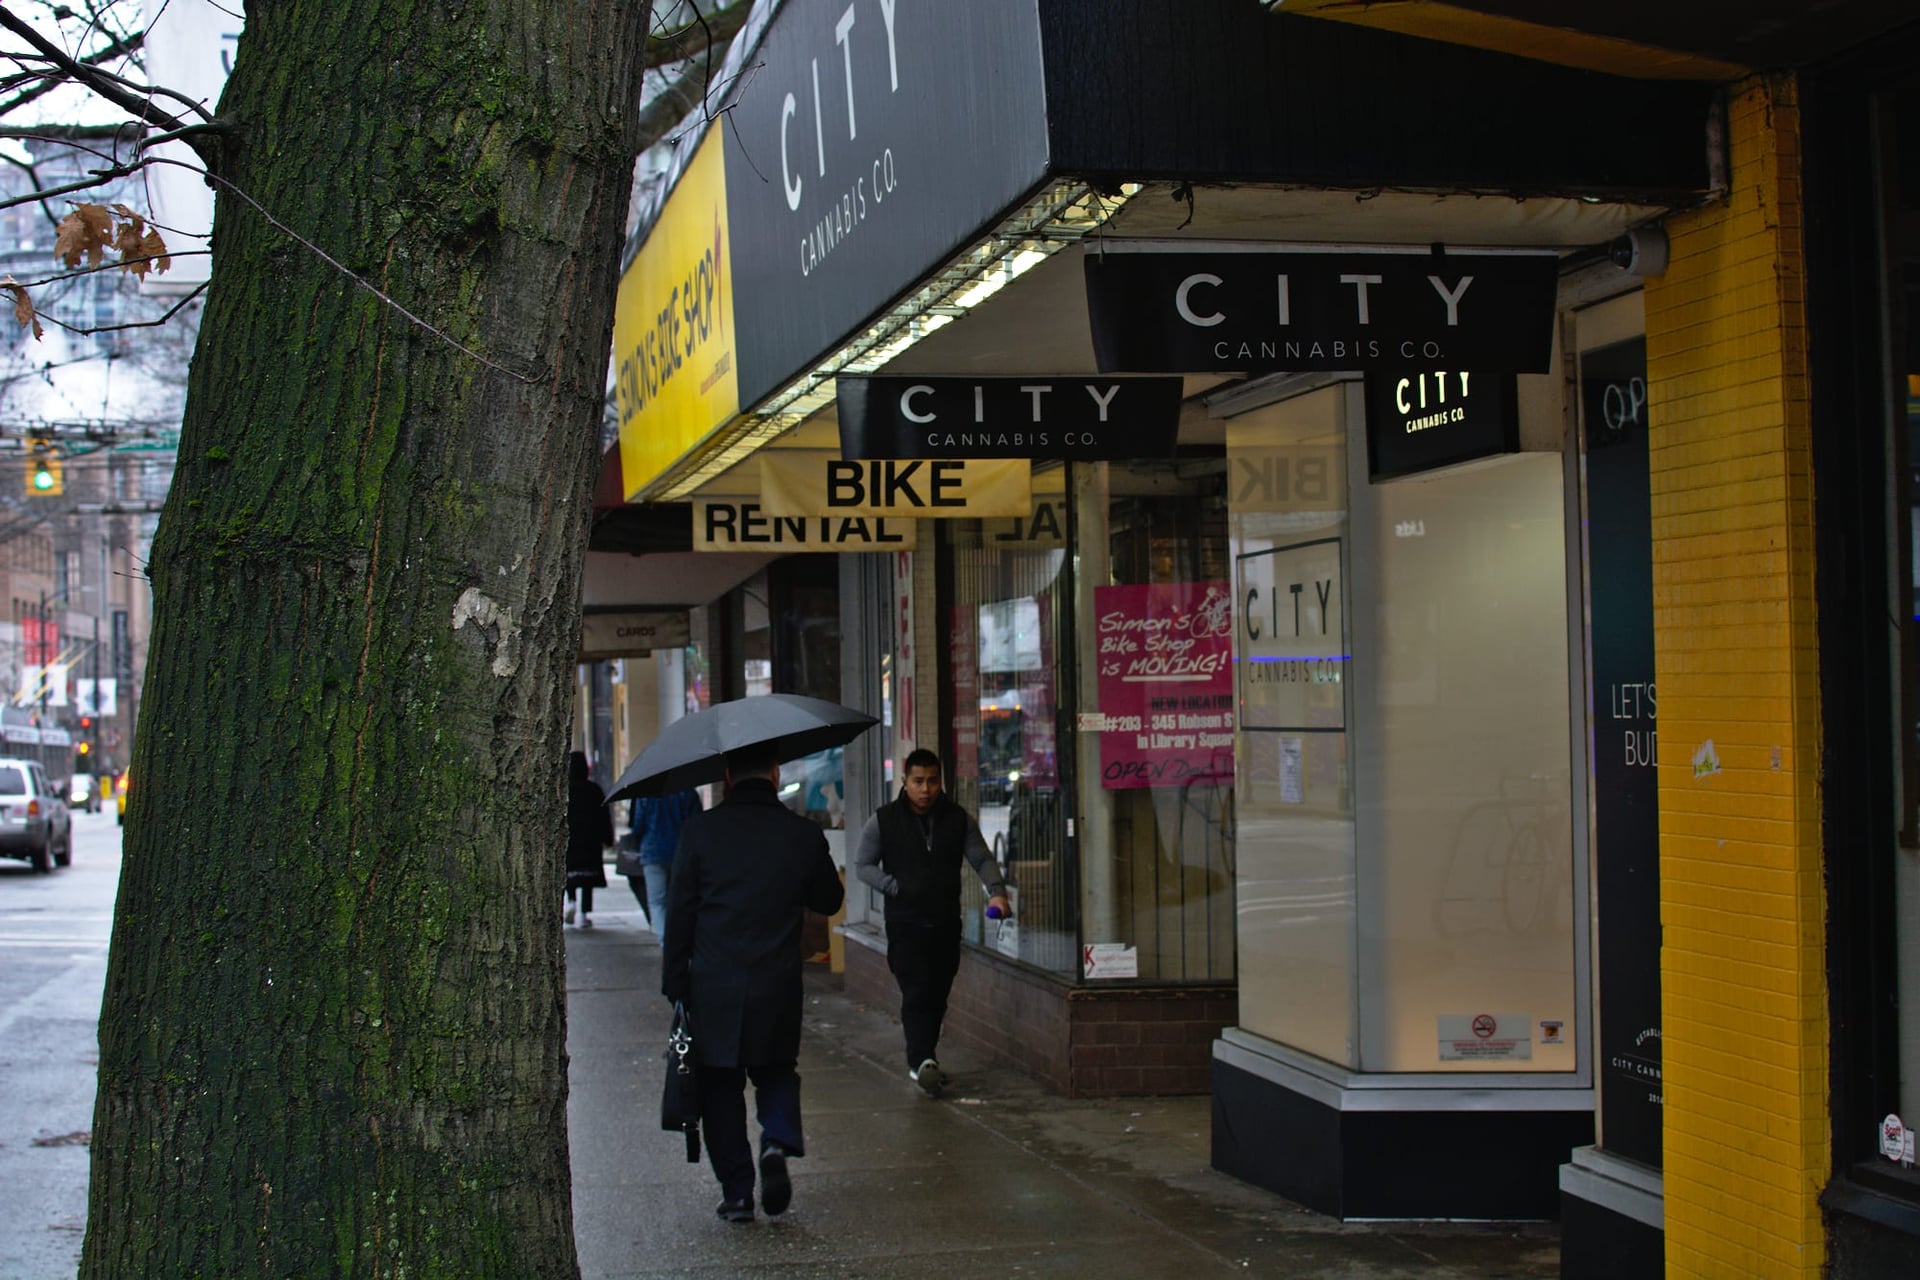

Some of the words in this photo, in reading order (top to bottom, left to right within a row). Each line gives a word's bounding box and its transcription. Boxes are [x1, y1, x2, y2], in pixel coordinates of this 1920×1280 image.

[800, 177, 865, 277] CANNABIS
[873, 148, 897, 203] CO.
[1175, 273, 1474, 327] CITY
[657, 286, 682, 386] BIKE
[683, 248, 713, 358] SHOP
[1214, 341, 1380, 358] CANNABIS
[1401, 341, 1445, 358] CO.
[901, 385, 1120, 423] CITY
[1396, 371, 1470, 414] CITY
[1406, 411, 1448, 433] CANNABIS
[928, 433, 1048, 446] CANNABIS
[1064, 432, 1097, 446] CO.
[827, 460, 966, 507] BIKE
[1100, 605, 1191, 632] Simon's
[1246, 580, 1331, 640] CITY
[617, 627, 656, 637] CARDS
[1100, 634, 1138, 655] Bike
[1144, 634, 1195, 655] Shop
[1101, 660, 1120, 676] is
[1127, 650, 1228, 675] MOVING!
[1248, 659, 1309, 683] CANNABIS
[1151, 696, 1178, 711] NEW
[1612, 682, 1657, 719] LET'S
[1152, 714, 1176, 730] 345
[1179, 713, 1222, 729] Robson
[1224, 711, 1233, 728] S
[1150, 733, 1196, 750] Library
[1104, 758, 1170, 780] OPEN
[1612, 1057, 1632, 1071] CITY
